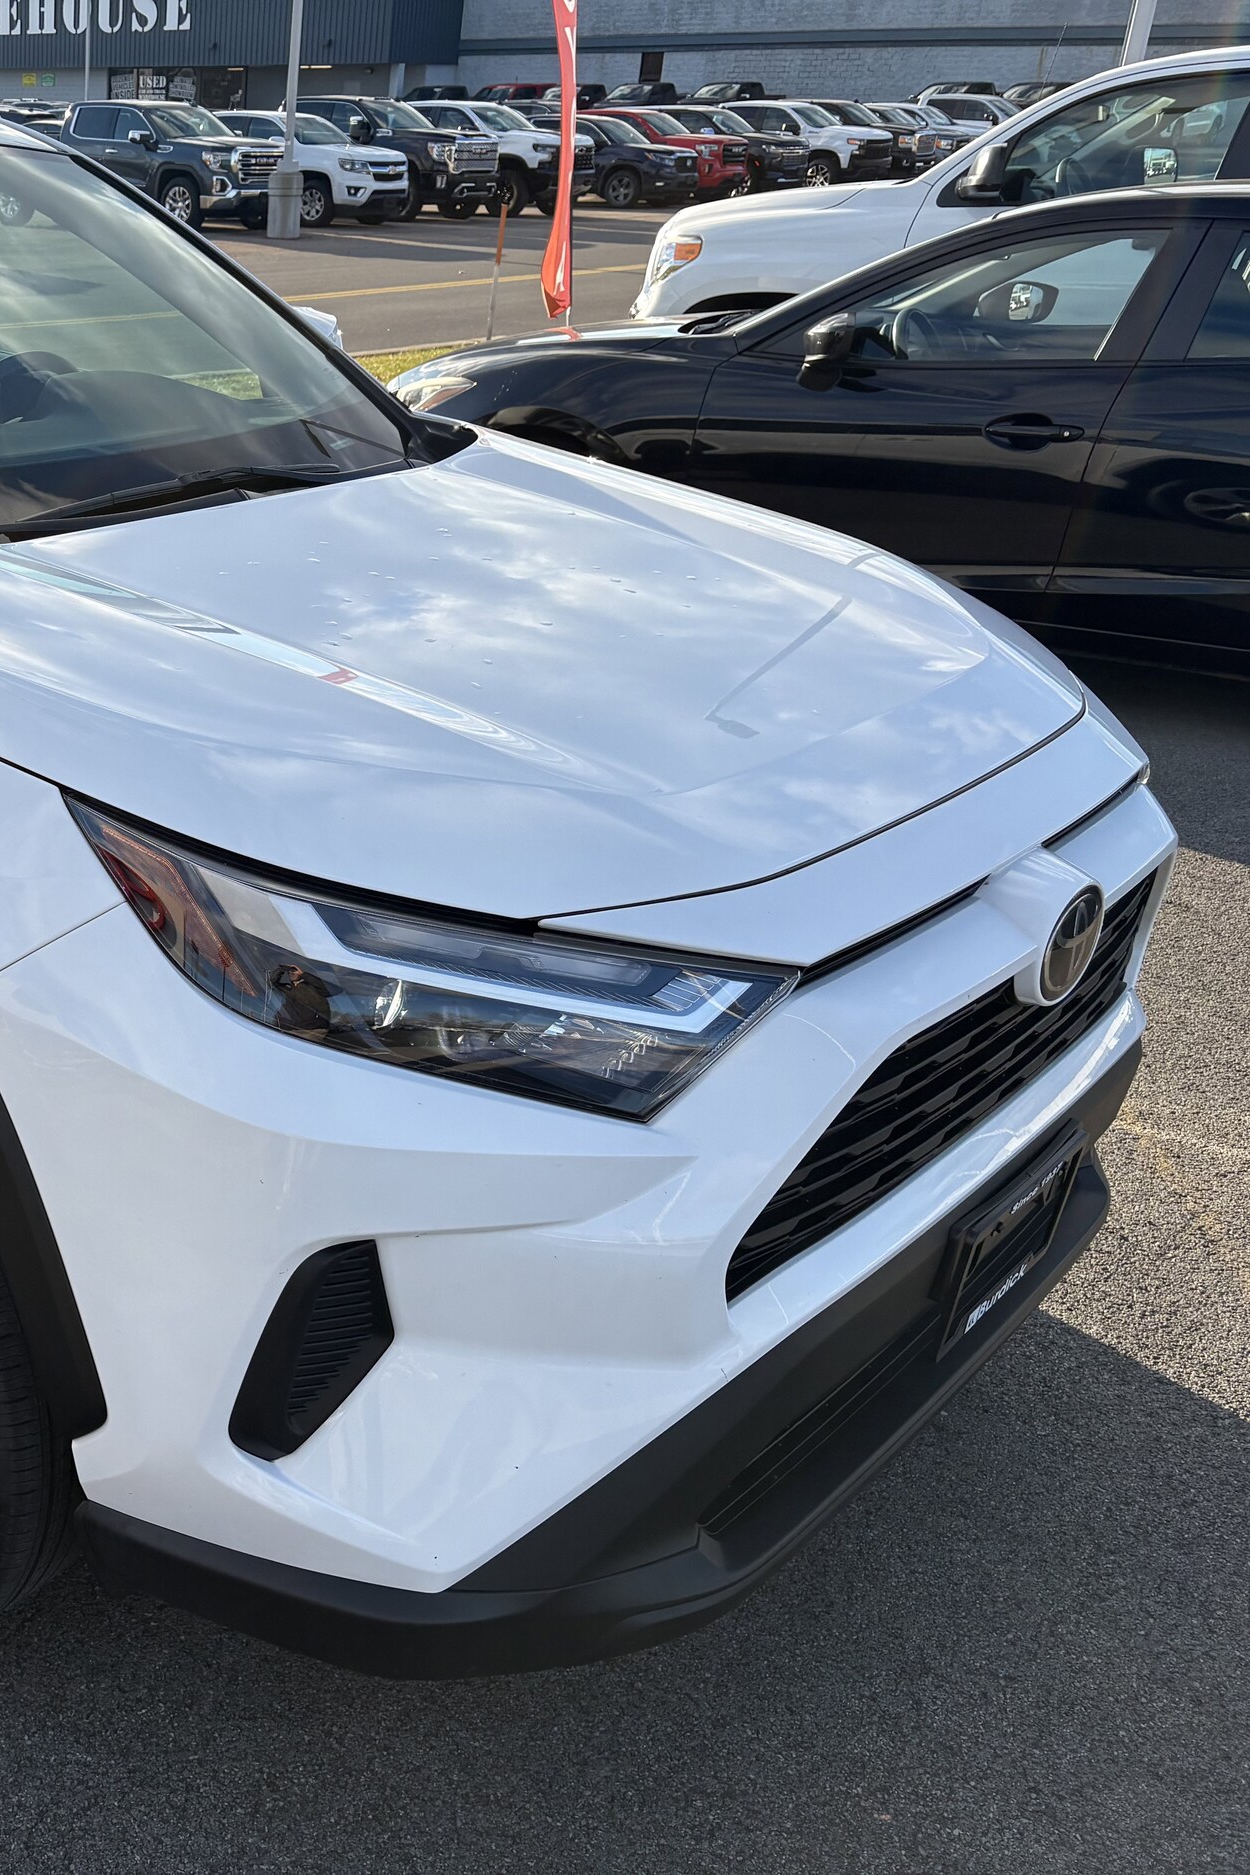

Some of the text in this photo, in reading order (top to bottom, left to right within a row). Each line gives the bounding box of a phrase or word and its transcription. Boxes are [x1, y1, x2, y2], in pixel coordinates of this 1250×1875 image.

[139, 75, 166, 88] USED
[1010, 1186, 1039, 1215] Since
[977, 1264, 1028, 1319] Burdick
